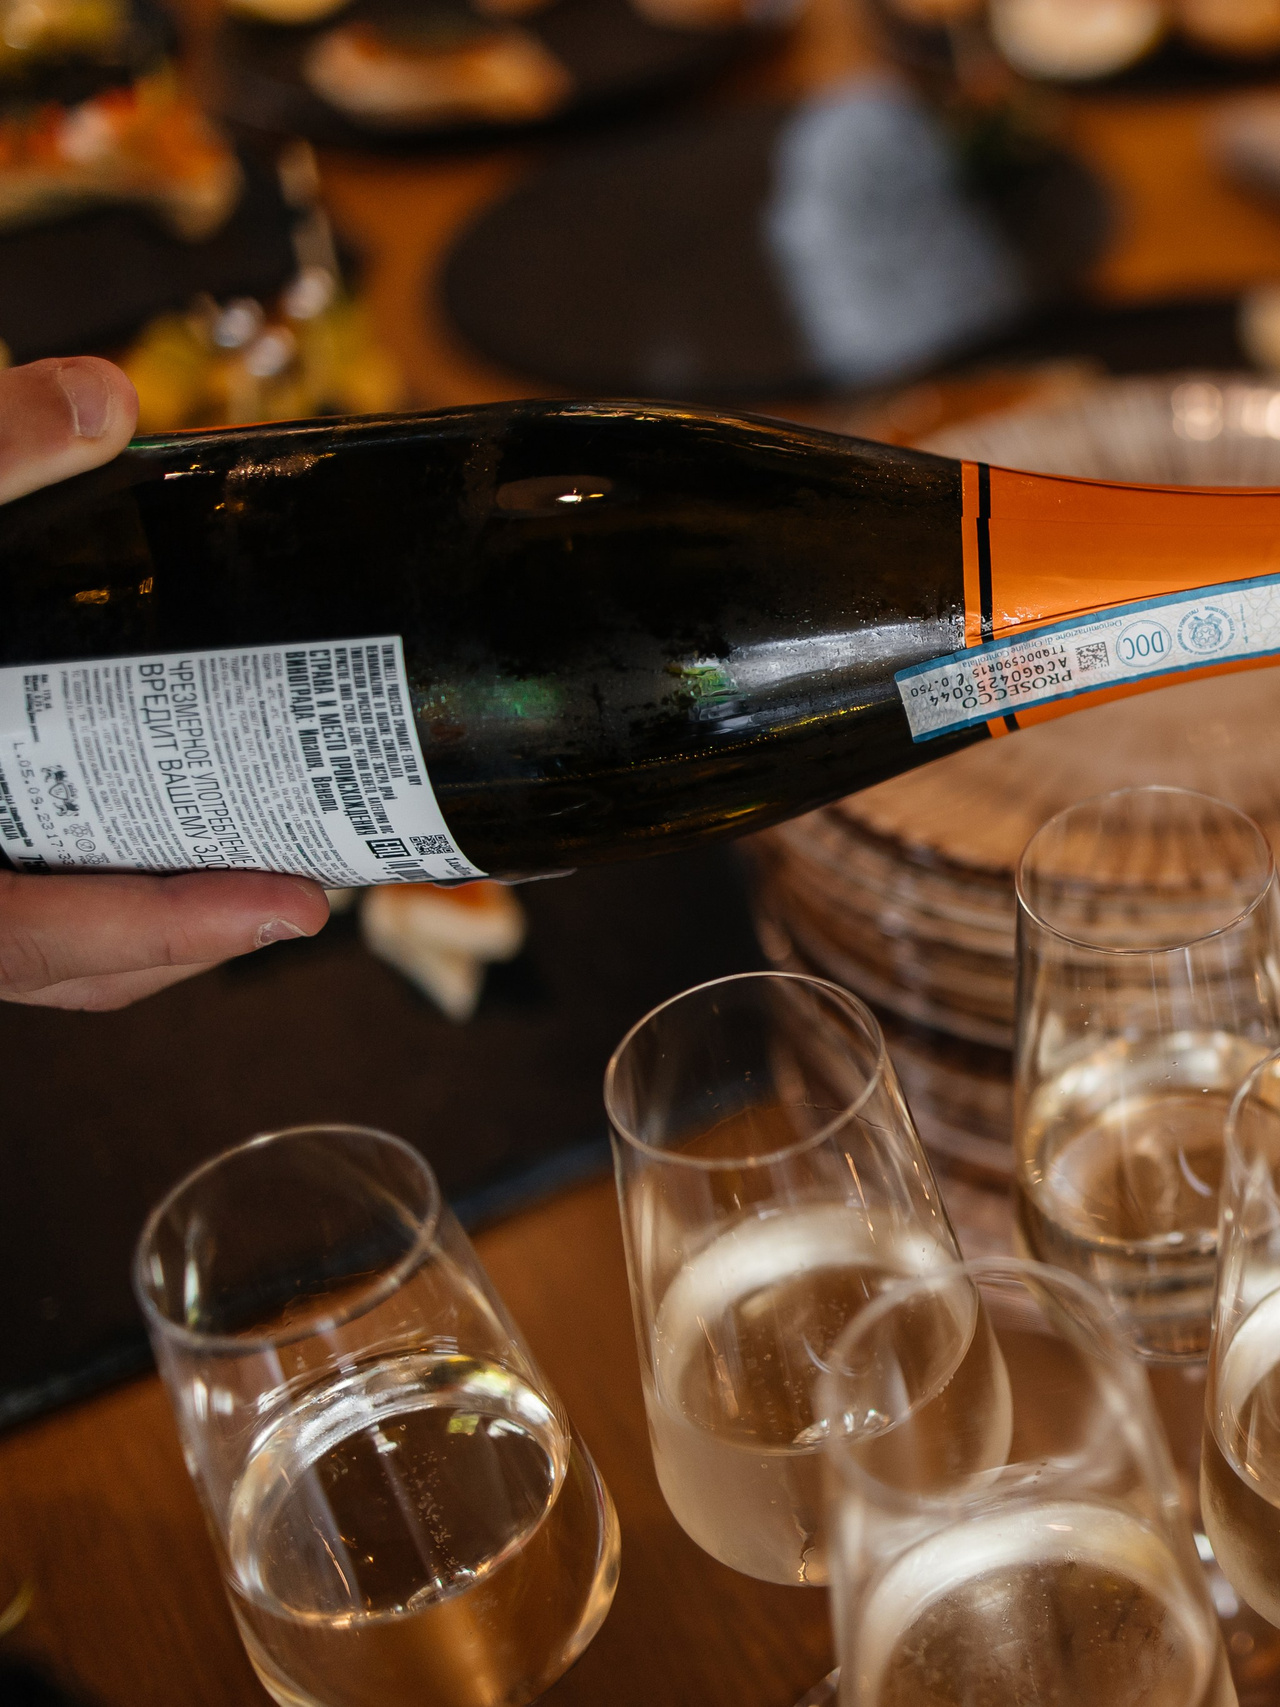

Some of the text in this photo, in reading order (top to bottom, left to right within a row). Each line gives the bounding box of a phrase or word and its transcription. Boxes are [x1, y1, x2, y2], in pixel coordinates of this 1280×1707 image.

[961, 619, 1123, 670] Denominazione di Origine Controllata
[1123, 631, 1164, 660] DOC
[309, 649, 334, 694] СТРАНА
[334, 648, 349, 679] ИГРИСТОЕ
[366, 645, 382, 697] DENOMINAZIONE
[339, 683, 352, 700] ВИНО
[929, 657, 1069, 707] ACQG04256044
[961, 670, 1073, 710] PROSECCO
[343, 704, 357, 723] СУХОЕ
[387, 683, 403, 716] PROSECCO
[285, 651, 338, 814] ВИНОГРАДА: Италия, Венето.
[319, 713, 347, 751] МЕСТО
[347, 727, 362, 745] БЕЛОЕ
[351, 647, 397, 800] ТИНТОНЕЛЛИ ПРОСЕККО СПУМАНТЕ ЭКСТРА ДРАЙ
[376, 711, 391, 735] ORIGINE
[393, 719, 411, 751] SPUMANTE
[138, 663, 178, 749] ВРЕДИТ
[158, 759, 210, 839] ВАШЕМУ
[193, 844, 232, 870] ЗДО
[169, 660, 211, 767] ЧРЕЗМЕРНОЕ
[192, 772, 255, 864] УПОТРЕБЛЕНИЕ
[353, 749, 369, 770] РЕГИОН
[382, 739, 403, 778] CONTROLLATA
[402, 755, 418, 773] EXTRA
[330, 756, 376, 835] ПРОИСХОЖДЕНИЯ
[359, 773, 377, 795] ВЕНЕТО,
[407, 775, 422, 785] DRY
[368, 797, 389, 824] КАТЕГОРИЯ
[0, 818, 22, 841] ITALIA
[46, 834, 78, 867] 17:33
